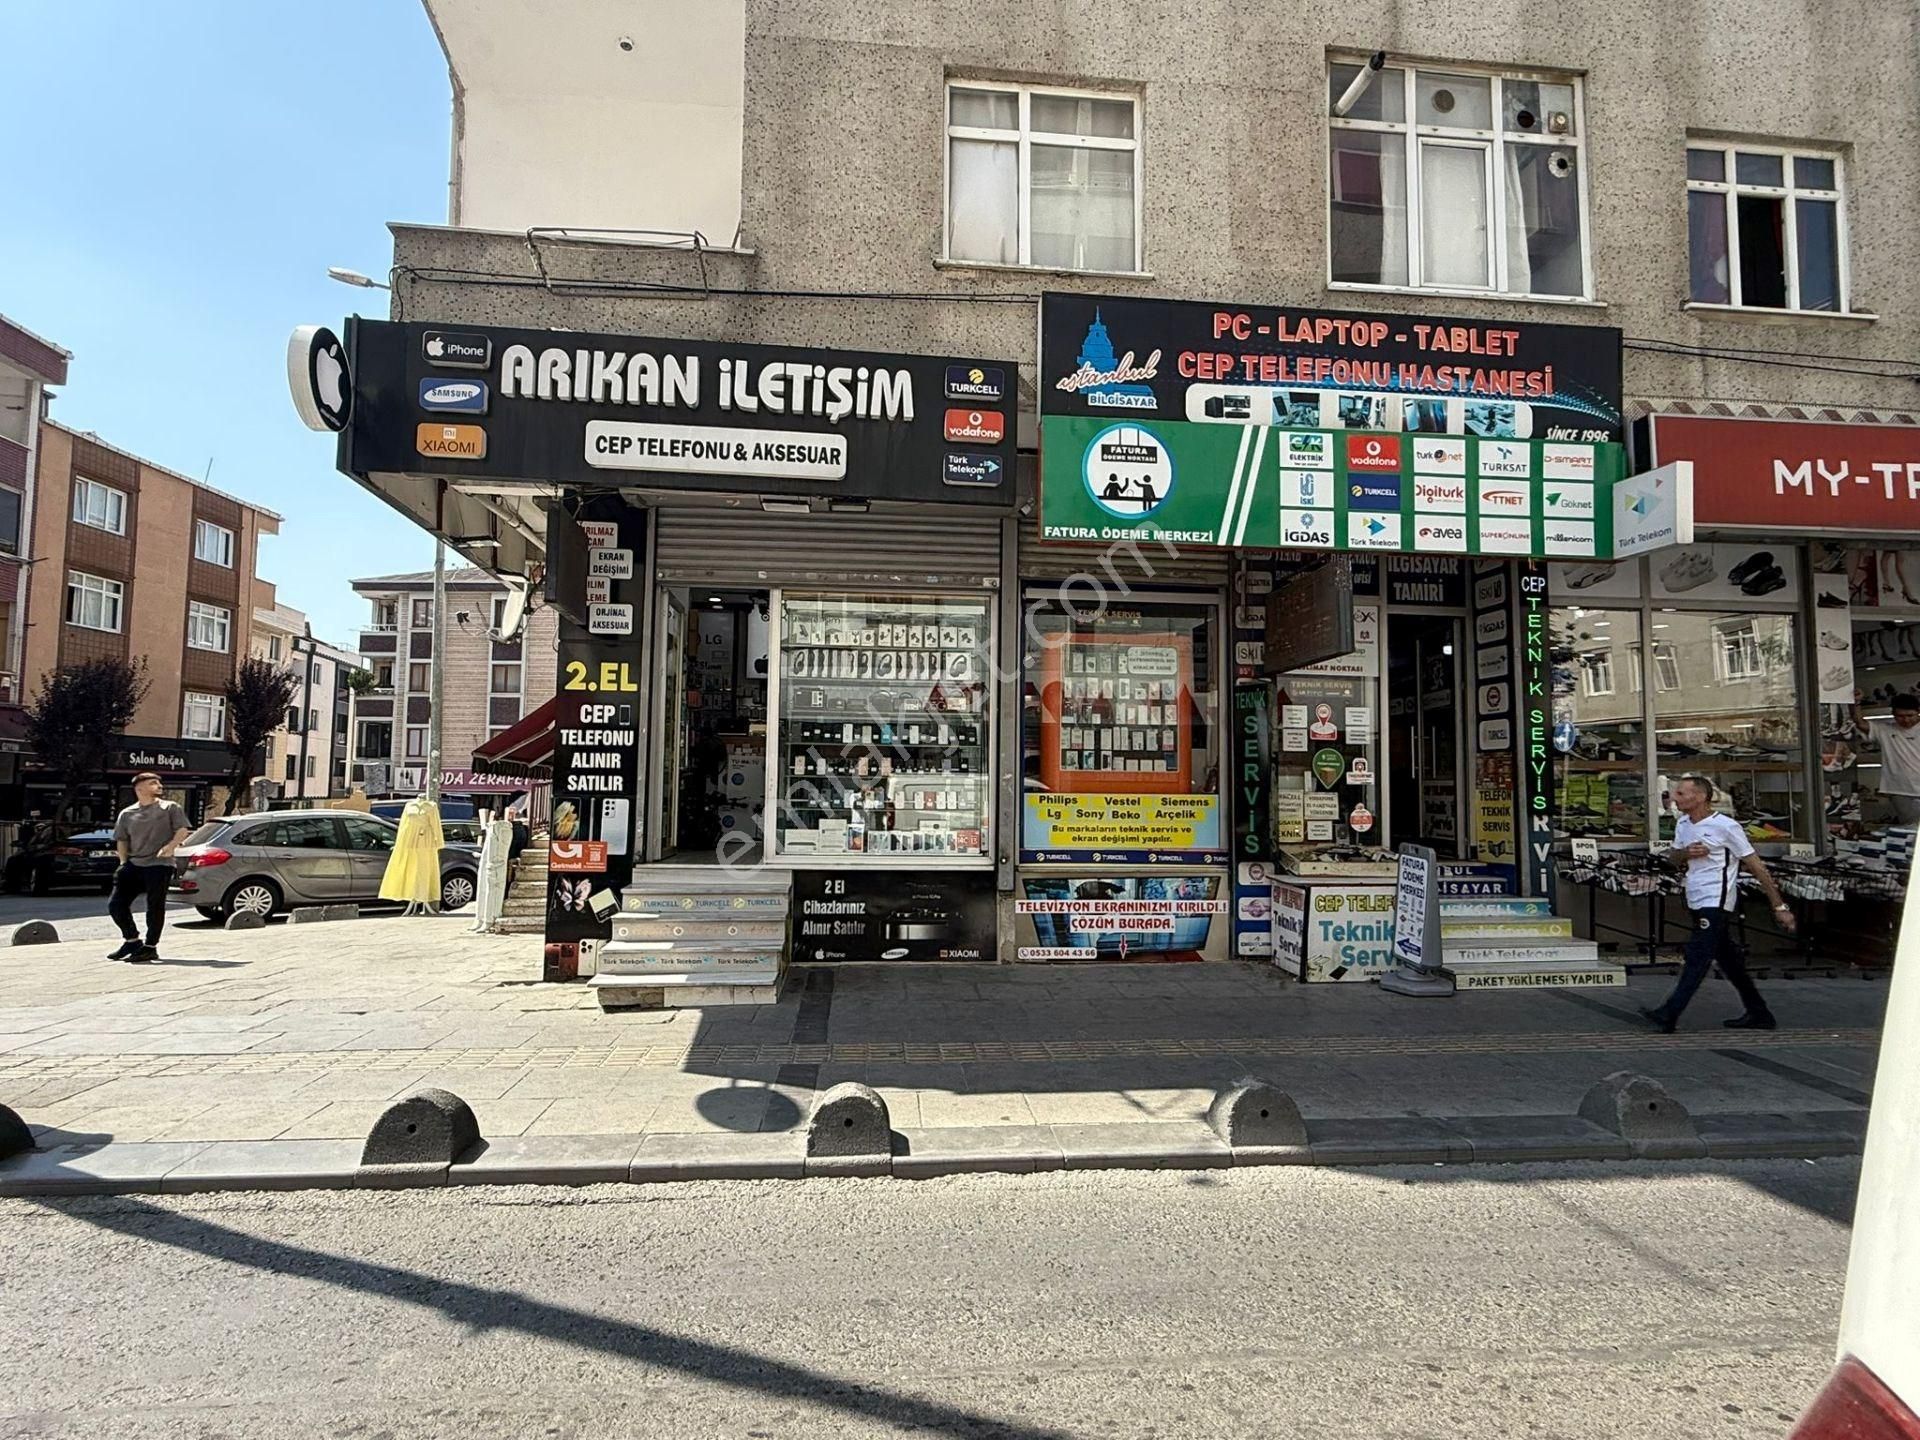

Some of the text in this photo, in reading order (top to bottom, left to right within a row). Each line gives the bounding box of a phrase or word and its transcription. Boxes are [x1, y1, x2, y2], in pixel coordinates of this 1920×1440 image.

[1213, 312, 1519, 356] PC - LAPTOP - TABLET
[447, 344, 485, 357] iPhone
[501, 344, 699, 409] ARIKAN
[1178, 351, 1553, 397] CEP TELEFONU HASTANESİ
[431, 388, 474, 399] SAMSUNG
[949, 383, 1000, 395] TURKCELL
[1089, 392, 1157, 408] BİLGİSAYAR
[949, 427, 1000, 439] vodafone
[1581, 429, 1609, 443] 1996
[423, 440, 475, 454] XIAOMI
[595, 434, 842, 467] CEP TELEFONU & AKSESUAR
[1110, 446, 1148, 455] FATURA
[948, 455, 968, 464] Türk
[1289, 454, 1324, 462] ELEKTRİK
[1351, 457, 1397, 466] vodafone
[948, 464, 986, 474] Telekom
[1482, 462, 1527, 473] TURKSAT
[1364, 488, 1398, 497] TURKCELL
[1416, 484, 1464, 504] Digiturk
[1492, 496, 1524, 506] TTNET
[584, 526, 615, 536] RILMAZ
[1044, 526, 1213, 543] FATURA ÖDEME MERKEZİ
[1284, 529, 1330, 544] İGDAŞ
[1433, 528, 1463, 539] avea
[1618, 525, 1672, 549] Türk Telekom
[1351, 538, 1400, 547] Türk Telekom
[598, 552, 625, 561] EKRAN
[592, 564, 629, 575] DEĞİŞİMİ
[587, 580, 605, 590] ILIM
[1393, 577, 1443, 602] TAMİRİ
[1521, 576, 1546, 593] CEP
[586, 592, 608, 602] LEME
[595, 607, 626, 617] ORJİNAL
[592, 620, 630, 630] AKSESUAR
[705, 634, 723, 645] LG
[1526, 597, 1544, 697] TEKNİK
[564, 660, 638, 692] 2.EL
[580, 704, 616, 723] CEP
[560, 729, 635, 746] TELEFONU
[571, 752, 622, 769] ALINIR
[1530, 709, 1547, 810] SERVİS
[423, 771, 464, 786] ODA
[567, 775, 624, 791] SATILIR
[1244, 715, 1260, 854] SERVİS
[1039, 795, 1210, 807] Philips Vestel Siemens
[1479, 790, 1512, 801] TELEFON
[1047, 808, 1196, 820] Lg Sony Beko Arçelik
[1481, 805, 1511, 816] TEKNİK
[1052, 825, 1064, 833] Bu
[1066, 825, 1117, 833] markaların
[1119, 825, 1149, 834] teknik
[1151, 826, 1178, 834] servis
[1482, 820, 1511, 832] SERVİS
[1071, 834, 1173, 844] ekran değişimi yapılır.
[1401, 856, 1425, 872] FATURA
[1402, 868, 1424, 886] ÖDEME
[824, 879, 845, 895] 2 El
[1400, 882, 1425, 899] MERKEZİ
[1439, 881, 1502, 894] İSAYAR
[643, 898, 782, 908] TURKCELL TURKCELL TURKCELL
[803, 900, 866, 915] Cihazlarınız
[1018, 900, 1090, 912] TELEVİZYON
[1094, 901, 1172, 912] EKRANINIZMI
[1314, 894, 1344, 913] CEP
[1346, 894, 1396, 913] TELEF
[802, 919, 866, 936] Alınır Satılır
[1071, 917, 1175, 931] ÇÖZÜM BURADA.
[1273, 909, 1298, 933] Teknik
[1318, 919, 1396, 942] Teknik
[826, 950, 846, 959] iPhone
[949, 950, 979, 959] XIAOMI
[1030, 949, 1096, 957] 0533 604 43 66
[1340, 944, 1401, 967] Serv
[1458, 949, 1492, 960] Türk
[1468, 972, 1614, 988] PAKET YÜKLEMESİ YAPILIR
